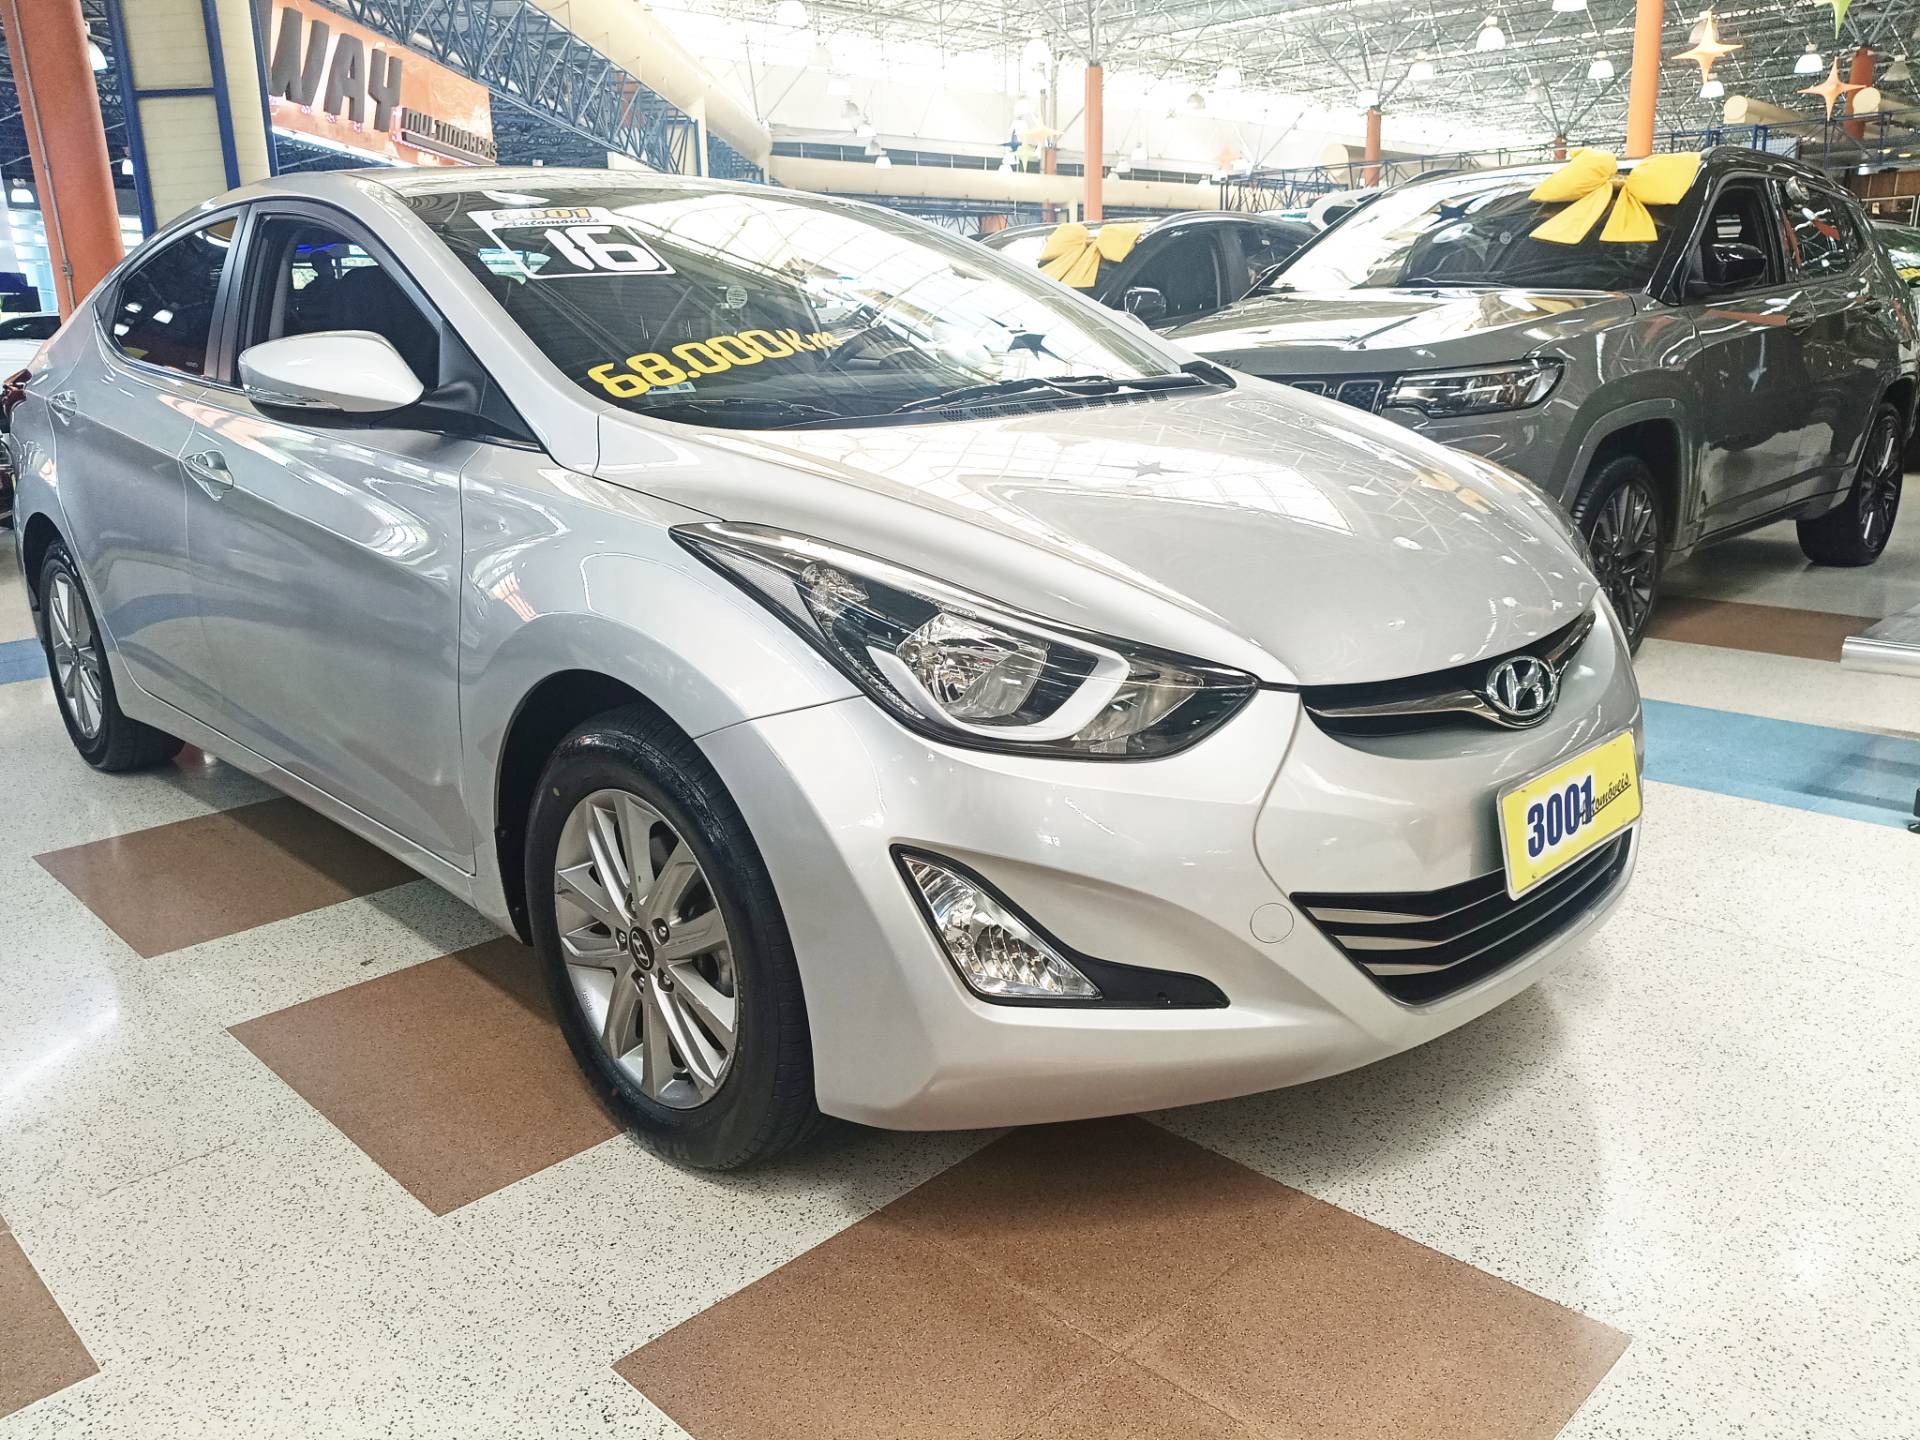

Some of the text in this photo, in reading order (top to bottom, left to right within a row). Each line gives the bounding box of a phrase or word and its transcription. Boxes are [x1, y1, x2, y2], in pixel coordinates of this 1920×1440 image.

[401, 107, 497, 160] MULTIMARCAS
[544, 226, 660, 271] 16
[1527, 774, 1592, 857] 3001
[1578, 772, 1631, 825] Atomóveis
